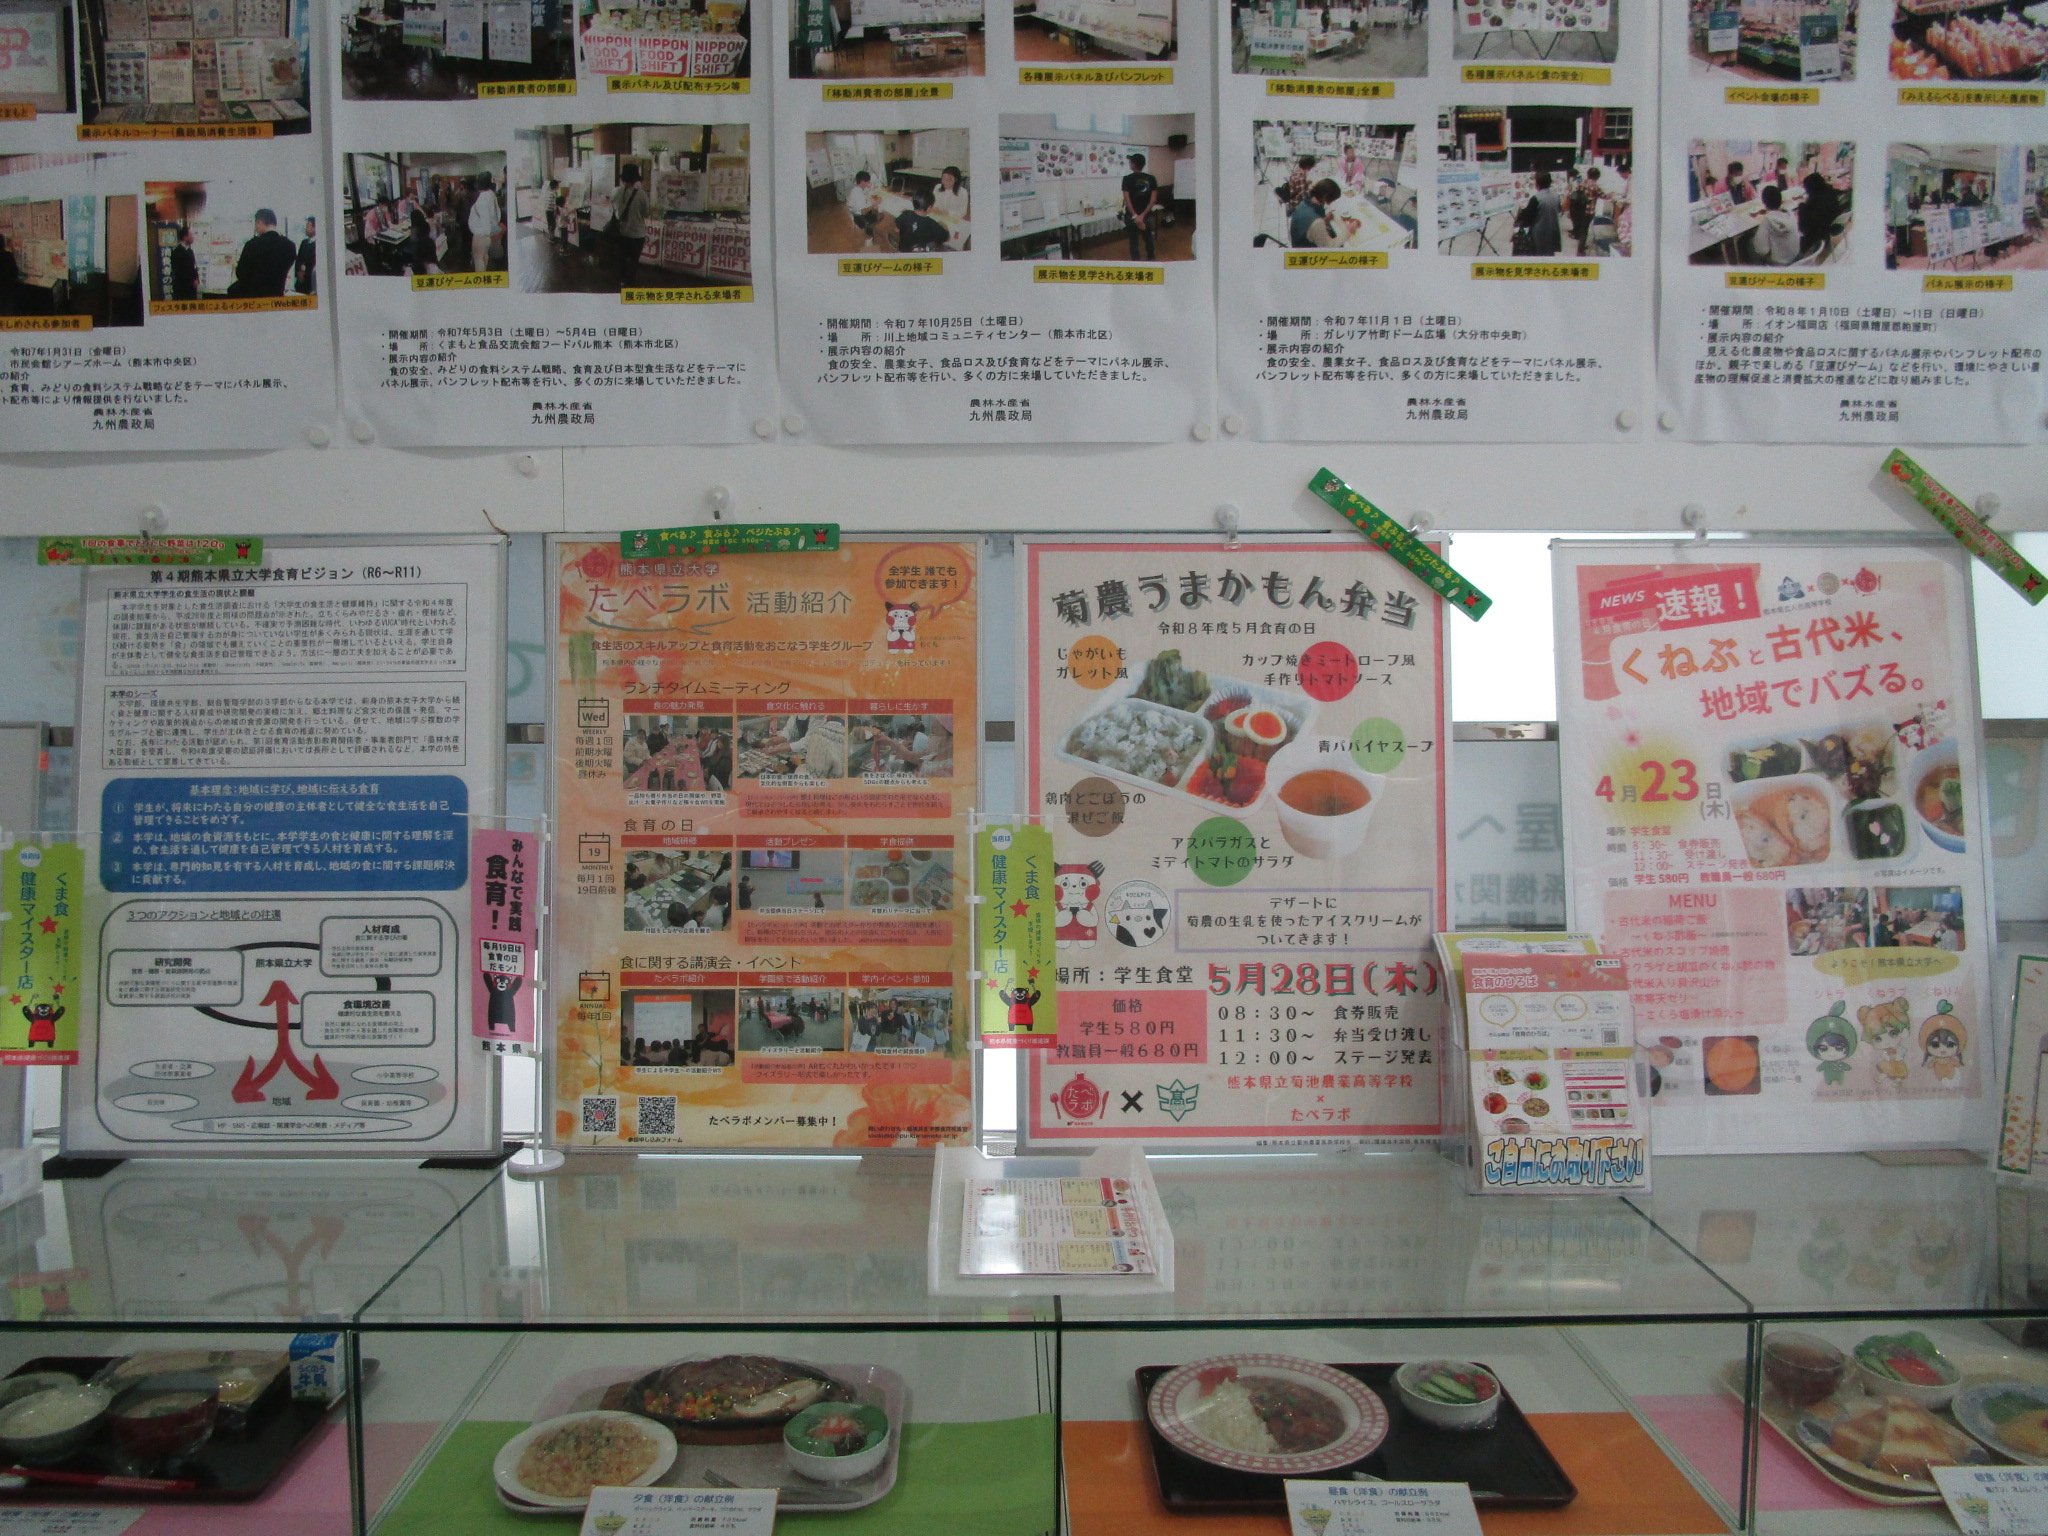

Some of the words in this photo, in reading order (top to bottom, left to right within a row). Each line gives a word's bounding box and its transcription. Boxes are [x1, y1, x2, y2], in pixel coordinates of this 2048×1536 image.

[639, 38, 689, 51] NIPPON
[695, 40, 745, 53] NIPPON
[640, 50, 674, 62] FOOD
[695, 52, 728, 64] FOOD
[640, 60, 678, 73] SHIFT
[694, 62, 731, 75] SHIFT
[1023, 71, 1165, 83] 各種展示パネル及びパンフレット
[479, 84, 573, 96] 「移動消費者の部屋」
[611, 79, 740, 92] 展示パネル及び配布チラシ等
[1269, 84, 1380, 97] 「移動消費者の部屋」全景
[826, 86, 939, 99] 「移動消費者の部屋」全景
[1728, 91, 1810, 103] イベント会場の様子
[665, 231, 707, 243] NIPPON
[665, 241, 693, 252] FOOD
[664, 250, 697, 265] SHIFT
[1289, 254, 1378, 266] 豆運びゲームの様子
[843, 261, 932, 273] 豆運びゲームの様子
[1475, 266, 1590, 277] 展示物を見学される来場者
[417, 275, 502, 287] 豆運びゲームの様子
[1038, 269, 1154, 282] 展示物を見学される来場者
[1729, 276, 1815, 287] 豆運びゲームの様子
[1926, 279, 2005, 290] パネル展示の様子
[625, 290, 741, 303] 展示物を見学される来場者
[533, 402, 593, 411] 農林水産省
[970, 399, 1031, 408] 農林水産省
[1407, 398, 1467, 407] 農林水産省
[1839, 400, 1898, 409] 農林水産省
[93, 407, 153, 416] 農林水産省
[969, 410, 1032, 422] 九州農政局
[1406, 409, 1469, 421] 九州農政局
[1838, 411, 1899, 423] 九州農政局
[92, 419, 155, 430] 九州農政局
[531, 413, 595, 425] 九州農政局
[151, 566, 422, 583] 第4期熊本県立大学食育ビジョン（R6～R11）
[619, 562, 720, 577] 熊本県立大学
[888, 565, 922, 577] 全学生
[924, 565, 958, 577] 誰でも
[885, 578, 959, 591] 参加できます！
[588, 582, 731, 615] たべラボ
[746, 590, 853, 615] 活動紹介
[1052, 568, 1420, 632] 菊農うまかもん弁当
[1600, 589, 1646, 609] NEWS
[1655, 586, 1748, 623] 速報！
[1157, 621, 1316, 636] 令和8年度5月食育の日
[591, 640, 873, 653] 食生活のスキルアップと食育活動をおこなう学生グループ
[1622, 611, 1903, 685] くねぶと古代米、
[1057, 647, 1127, 661] じゃがいも
[1242, 653, 1416, 667] カップ焼きミートローフ風
[1057, 666, 1129, 681] ガレット風
[1264, 673, 1393, 687] 手作りトマトソース
[110, 689, 158, 699] 本学のシーズ
[624, 681, 791, 696] ランチタイムミーティング
[1699, 662, 1925, 721] 地域でバズる。
[653, 701, 705, 711] 食の魅力発見
[766, 701, 825, 711] 食文化に触れる
[870, 701, 929, 711] 暮らしに生かす
[581, 712, 606, 724] Wed
[575, 736, 613, 747] 毎週1回
[1318, 739, 1434, 753] 青パパイヤスープ
[575, 747, 613, 757] 前期水曜
[575, 758, 613, 768] 後期火曜
[578, 769, 607, 780] 昼休み
[1595, 758, 1722, 804] 4月23日
[190, 783, 380, 796] 基本理念：地域に学び、地域に伝える食育
[1045, 792, 1146, 806] 鶏肉とごぼうの
[133, 814, 245, 826] 管理できることをめざす。
[1067, 811, 1125, 825] 混ぜご飯
[623, 818, 694, 832] 食育の日
[1606, 826, 1626, 837] 場所
[1630, 825, 1672, 837] 学生食堂
[663, 836, 698, 846] 地域研修
[765, 837, 816, 847] 活動プレゼン
[879, 837, 914, 846] 学食提供
[991, 835, 1011, 843] 当店は
[1171, 836, 1272, 850] アスパラガスと
[588, 848, 601, 857] 19
[1606, 842, 1627, 853] 時間
[1151, 855, 1295, 869] ミディトマトのサラダ
[132, 873, 185, 885] に貢献する。
[577, 874, 615, 884] 毎月1回
[1025, 855, 1040, 900] くま食
[1608, 876, 1629, 888] 価格
[1634, 873, 1656, 884] 学生
[1658, 872, 1690, 884] 580円
[1756, 870, 1786, 882] 680円
[509, 839, 524, 932] みんなで実践
[577, 885, 617, 896] 19日前後
[54, 872, 69, 917] くま食
[486, 854, 509, 930] 食育！
[1269, 896, 1337, 910] デザートに
[1669, 894, 1717, 908] MENU
[991, 854, 1008, 974] 健康マイスター店
[1187, 914, 1422, 929] 菊農の生乳を使ったアイスクリームが
[17, 871, 37, 990] 健康マイスター店
[362, 924, 401, 934] 人材育成
[1256, 932, 1351, 946] ついてきます！
[483, 941, 522, 953] 毎月19日は
[155, 957, 192, 967] 研究開発
[255, 958, 313, 968] 熊本県立大学
[488, 952, 518, 963] 食育の日
[621, 956, 801, 970] 食に関する講演会・イベント
[1831, 957, 1941, 969] ようこそ！熊本県立大学へ
[489, 962, 517, 973] だモン！
[654, 974, 705, 984] たべラボ紹介
[758, 974, 827, 984] 学園祭で活動紹介
[862, 974, 930, 984] 学内イベント参加
[1056, 966, 1193, 985] 場所：学生食堂
[1208, 961, 1439, 997] 5月28日（木）
[1473, 975, 1538, 988] 食育のひろば
[343, 1000, 392, 1010] 食環境改善
[1112, 998, 1143, 1013] 価格
[577, 1011, 612, 1021] 毎年1回
[1333, 1006, 1399, 1020] 食券販売
[1079, 1021, 1175, 1036] 学生580円
[1333, 1028, 1432, 1043] 弁当受け渡し
[1056, 1043, 1199, 1059] 教職員一般680円
[1334, 1050, 1433, 1065] ステージ発表
[1227, 1075, 1413, 1090] 熊本県立菊池農業高等学校
[271, 1097, 291, 1106] 地域
[708, 1115, 839, 1127] たべラボメンバー募集中！
[1290, 1108, 1351, 1122] たべラボ
[1485, 1137, 1644, 1185] ご自由にお取り下さい
[298, 1373, 327, 1387] 牛乳
